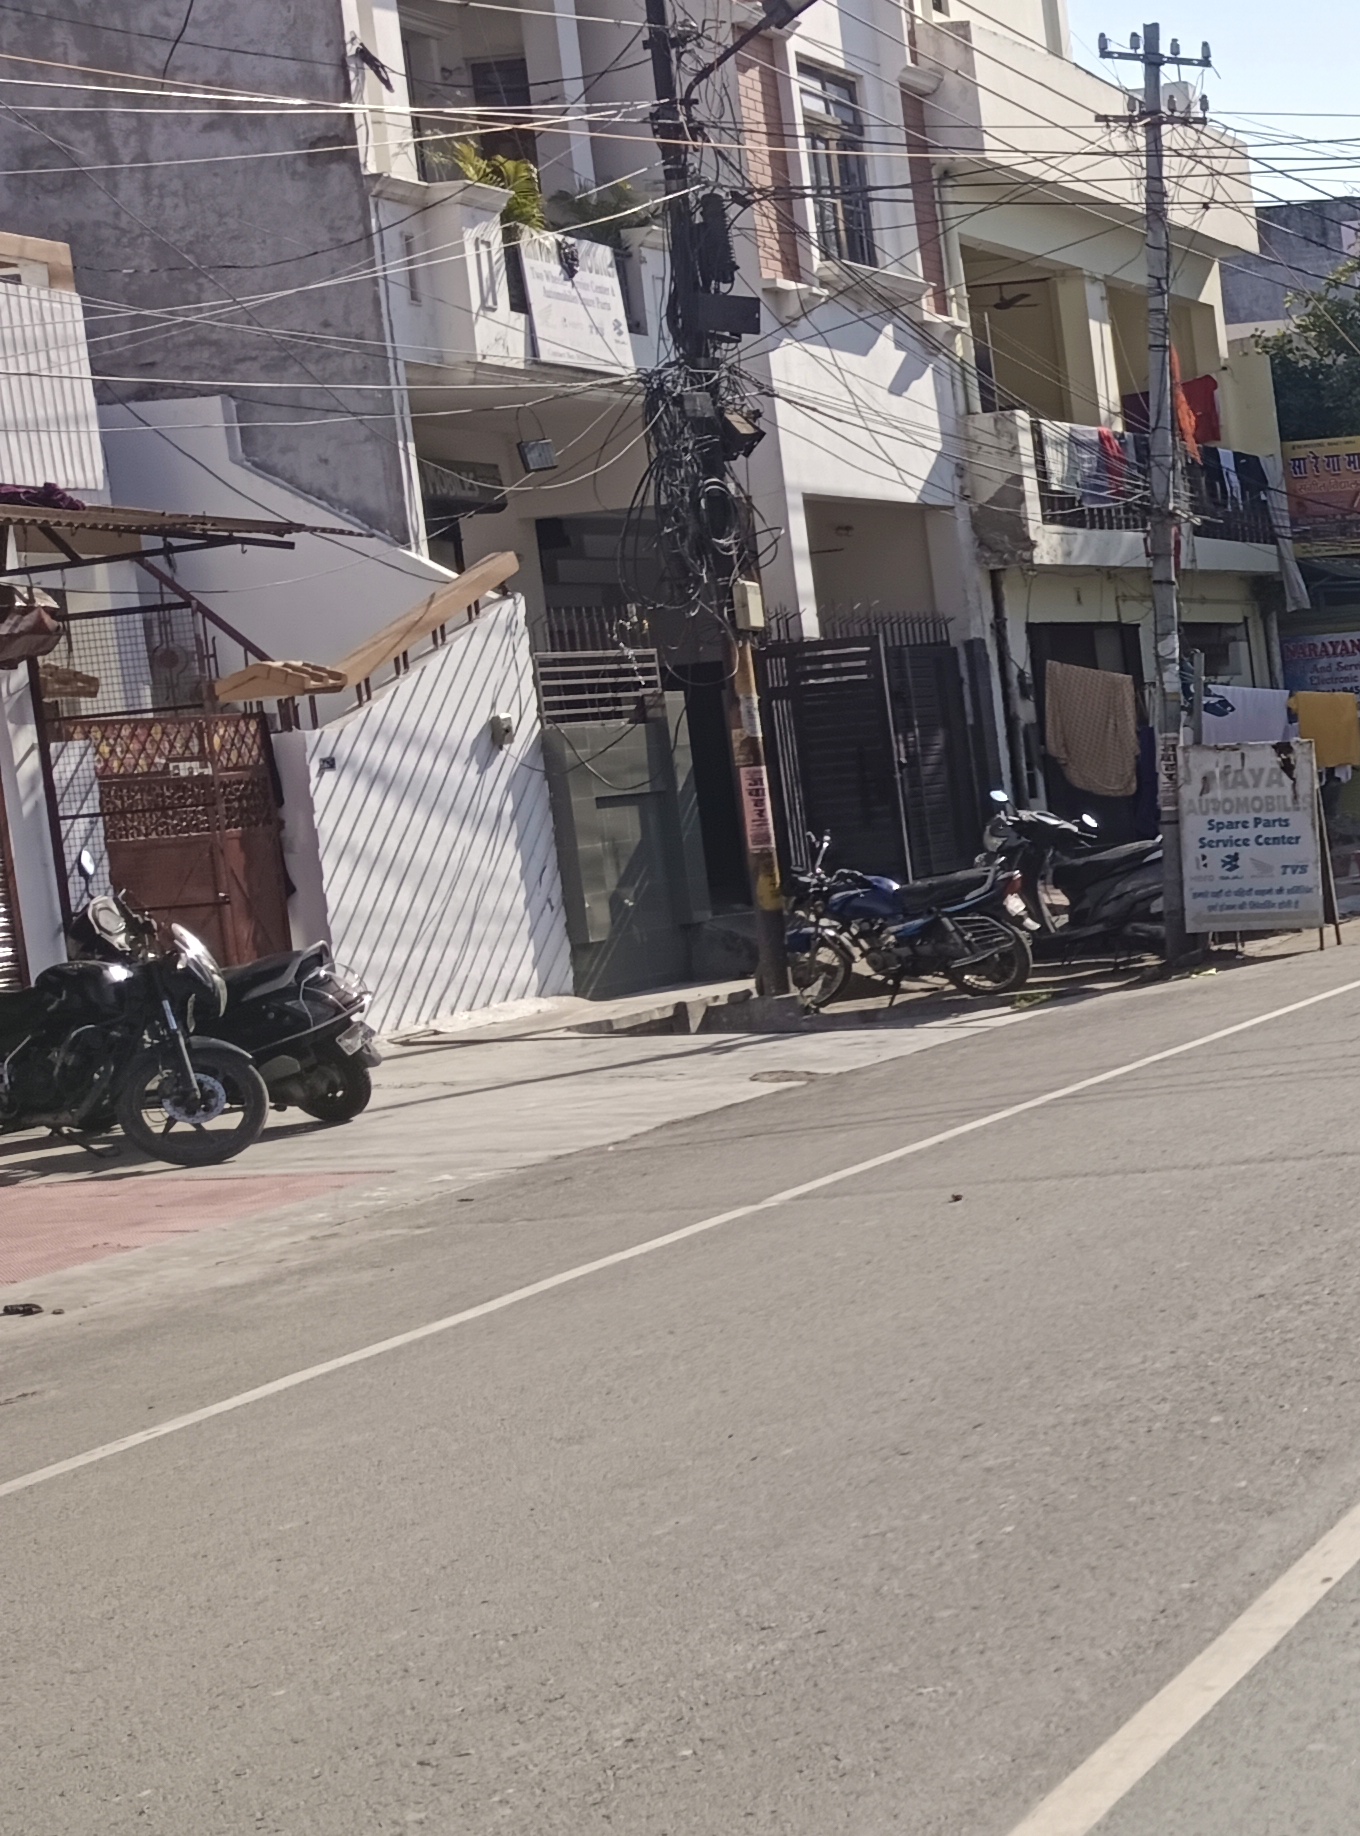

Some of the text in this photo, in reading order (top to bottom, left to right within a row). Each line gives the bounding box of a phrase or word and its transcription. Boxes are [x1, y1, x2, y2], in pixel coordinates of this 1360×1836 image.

[1289, 457, 1308, 477] सा
[1308, 451, 1321, 477] रे
[1324, 454, 1341, 476] गा
[1310, 663, 1332, 675] And
[1309, 674, 1359, 686] Electronic
[1207, 816, 1290, 833] Spare Parts
[1198, 834, 1301, 849] Service Center
[1281, 864, 1309, 876] TVS
